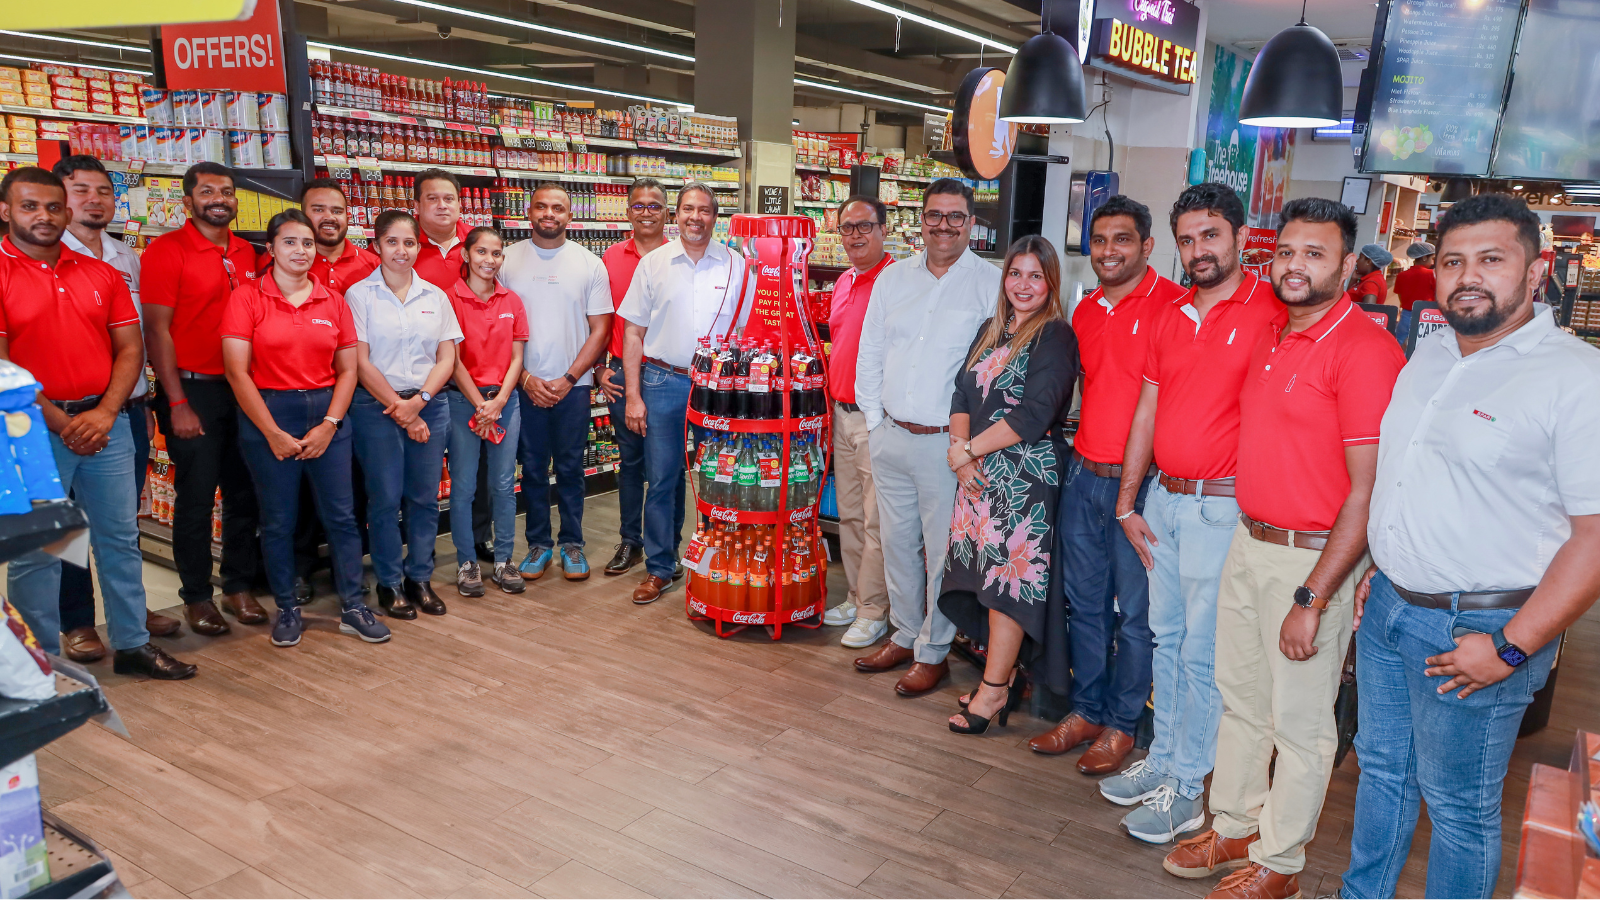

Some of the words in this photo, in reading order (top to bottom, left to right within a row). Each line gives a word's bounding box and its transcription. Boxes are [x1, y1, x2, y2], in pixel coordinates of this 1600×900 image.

[1161, 0, 1175, 24] Thai
[174, 34, 274, 70] OFFERS!
[1109, 18, 1172, 75] BUBBLE
[1174, 45, 1198, 83] TEA
[1392, 75, 1424, 84] MOJITO
[1215, 140, 1227, 165] The
[335, 168, 351, 179] 229
[1208, 160, 1248, 192] Treehouse
[765, 205, 781, 213] LAUGH
[770, 310, 794, 318] GRAT
[703, 416, 730, 431] Coca-Cola
[799, 416, 823, 431] Coca-Cola
[156, 463, 168, 476] 319
[710, 506, 739, 522] Coca-Cola
[790, 506, 813, 522] Coca-Cola
[732, 612, 766, 624] Coca-Cola
[791, 604, 815, 621] Coca-Cola
